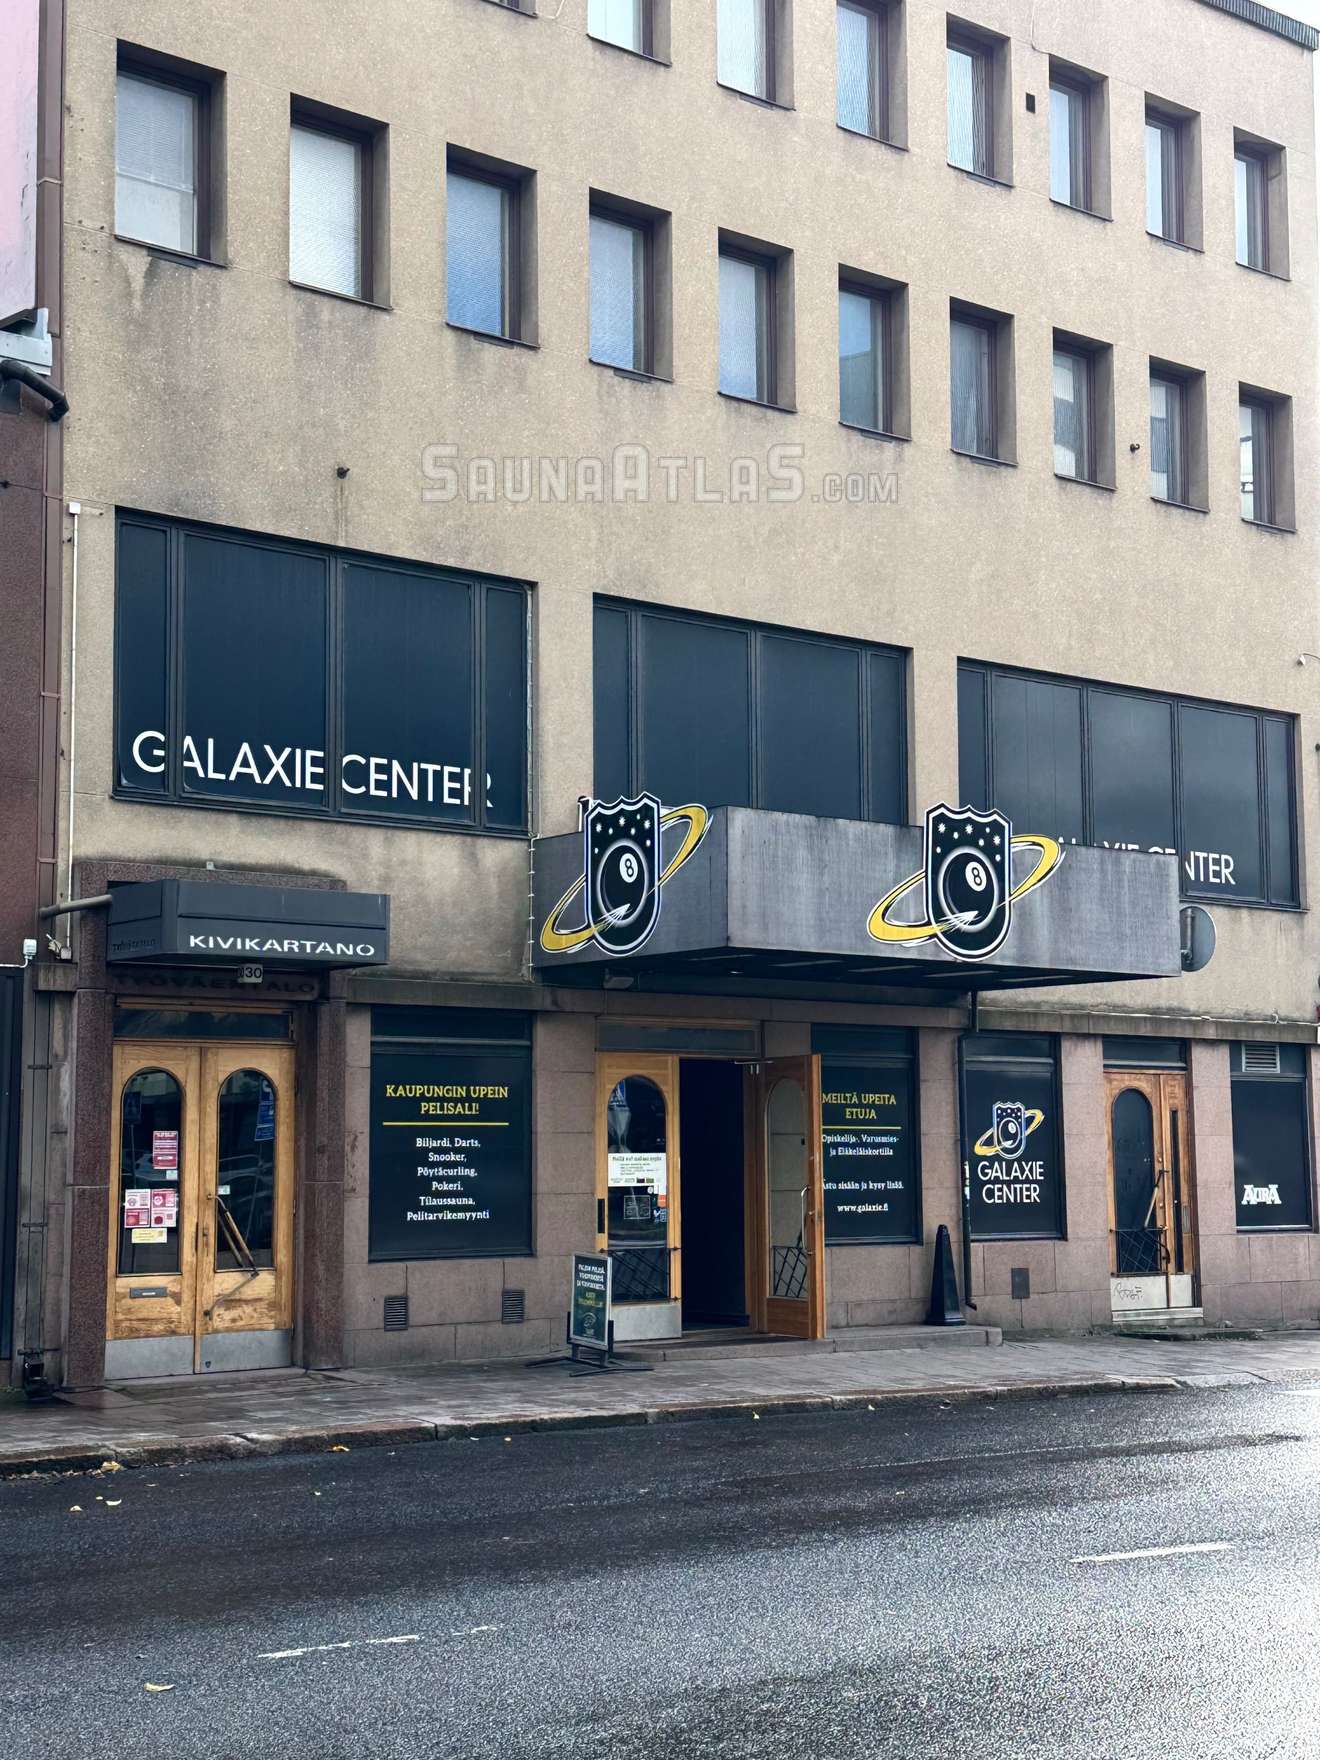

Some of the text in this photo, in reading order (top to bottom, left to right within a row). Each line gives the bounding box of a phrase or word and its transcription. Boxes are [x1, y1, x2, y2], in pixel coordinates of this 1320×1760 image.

[132, 730, 493, 808] GALAXIE CENTER
[625, 858, 635, 878] 8
[971, 866, 983, 887] 8
[189, 934, 375, 957] KIVIKARTANO
[386, 1084, 509, 1099] KAUPUNGIN UPEIN
[822, 1091, 897, 1105] MEILTÄ UPEITA
[420, 1102, 480, 1115] PELISALI!
[845, 1107, 877, 1120] ETUJA
[416, 1137, 481, 1149] Biljardi, Darts,
[428, 1151, 467, 1163] Snooker,
[977, 1160, 1045, 1181] GALAXIE
[982, 1183, 1041, 1204] CENTER
[419, 1196, 476, 1207] Tilaussauna,
[406, 1209, 491, 1222] Pelitarvikemyynti
